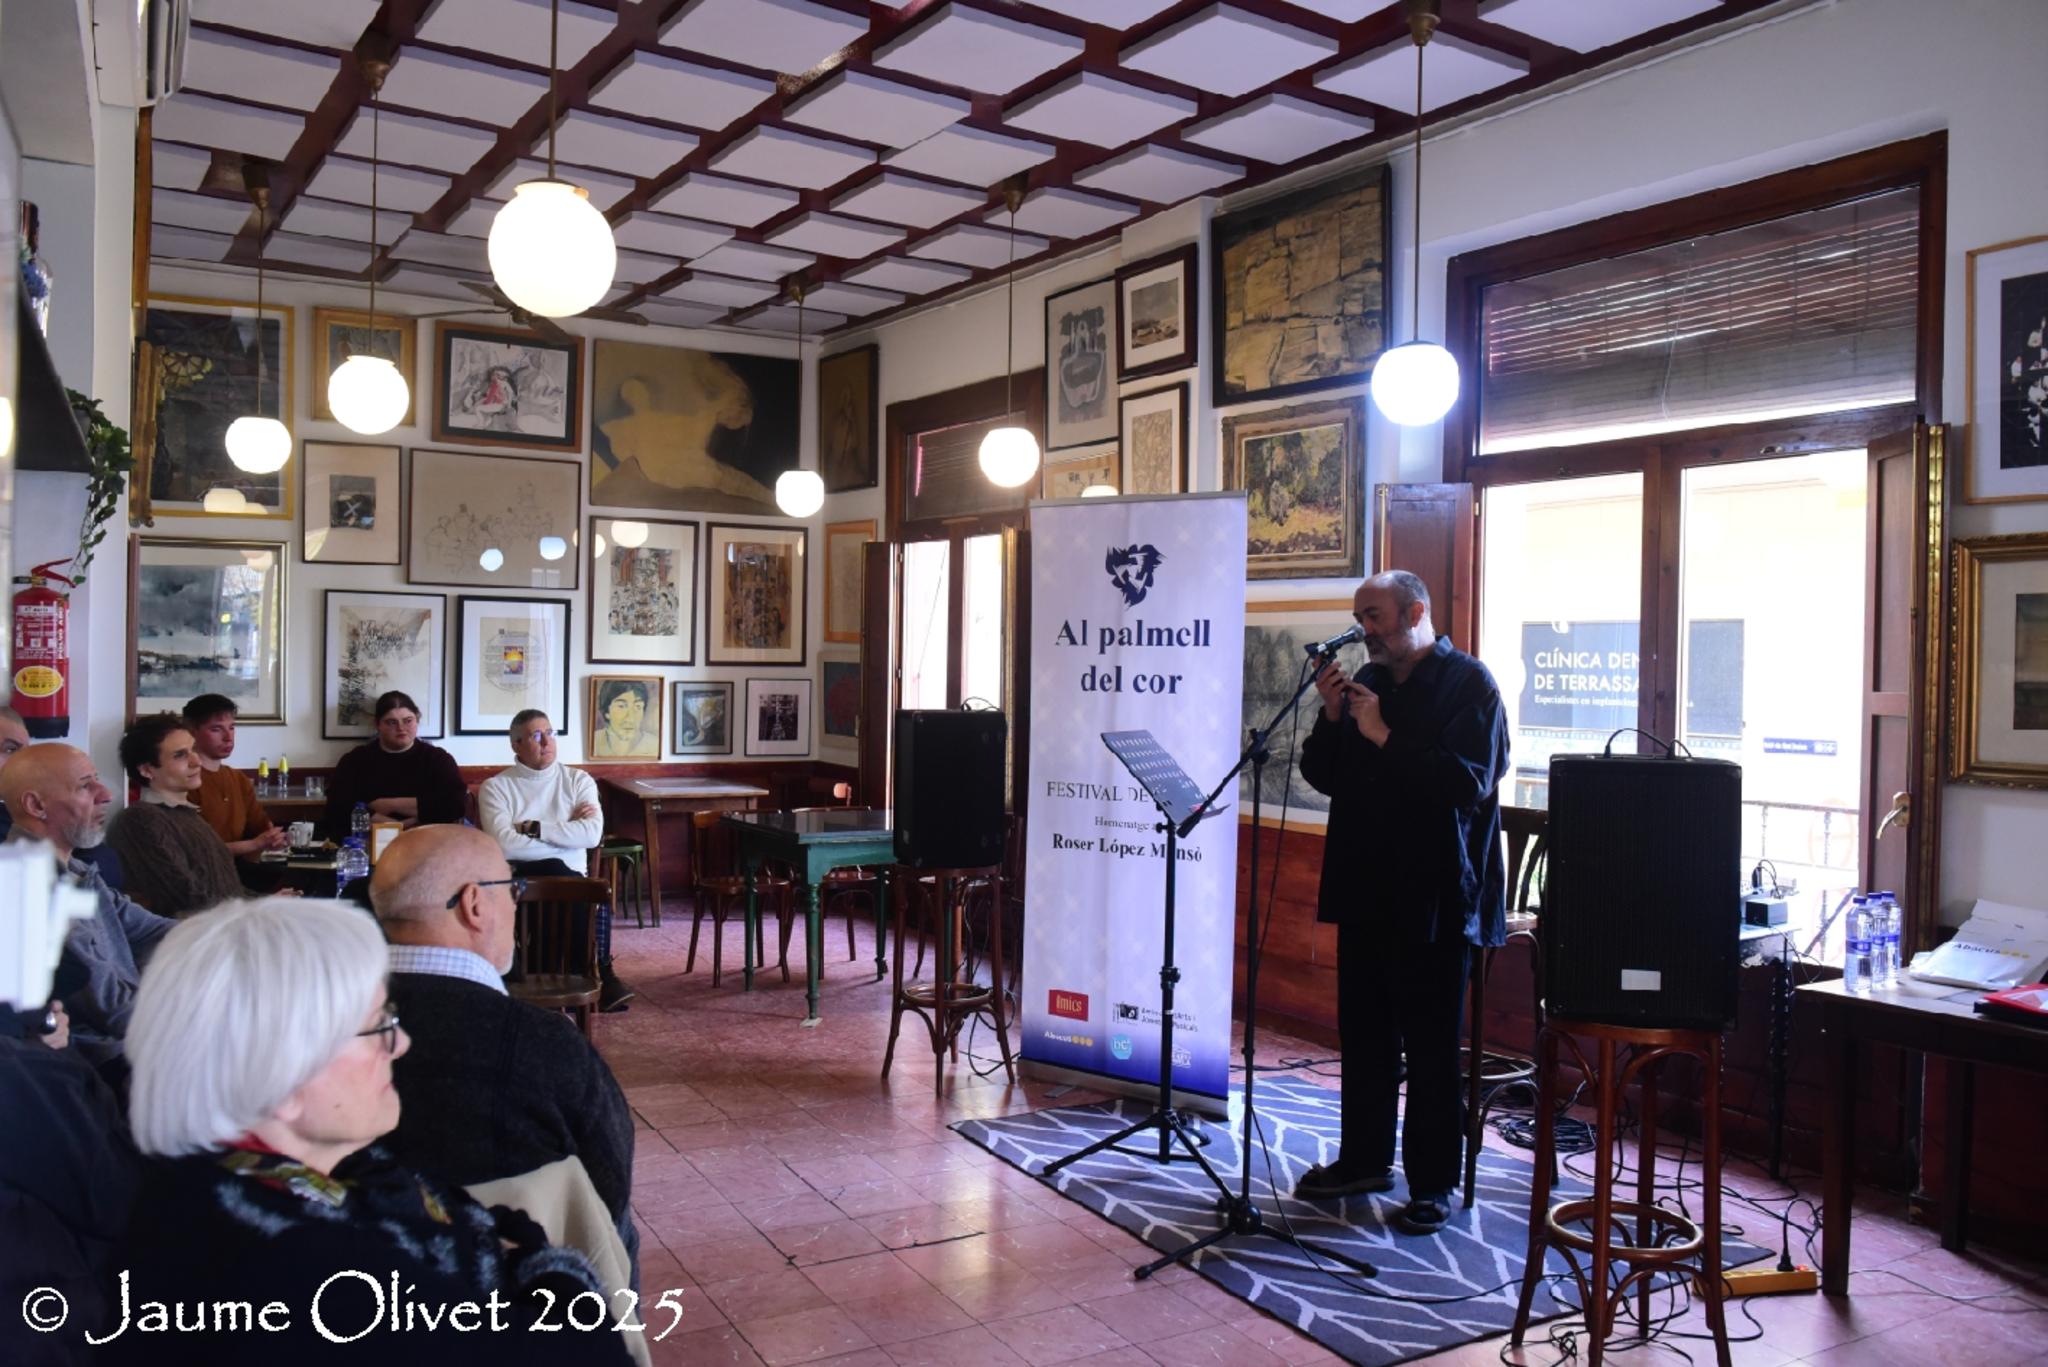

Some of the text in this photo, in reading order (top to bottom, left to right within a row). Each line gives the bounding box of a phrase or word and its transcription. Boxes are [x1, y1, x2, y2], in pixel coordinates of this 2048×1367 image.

[1055, 619, 1211, 655] Al palmell
[1534, 647, 1640, 669] CLÍNICA DEN
[1080, 665, 1183, 694] del cor
[1534, 673, 1554, 690] DE
[1046, 781, 1123, 802] FESTIVAL
[1053, 833, 1202, 862] Roser López Mnsò
[1952, 943, 2001, 954] Abacus
